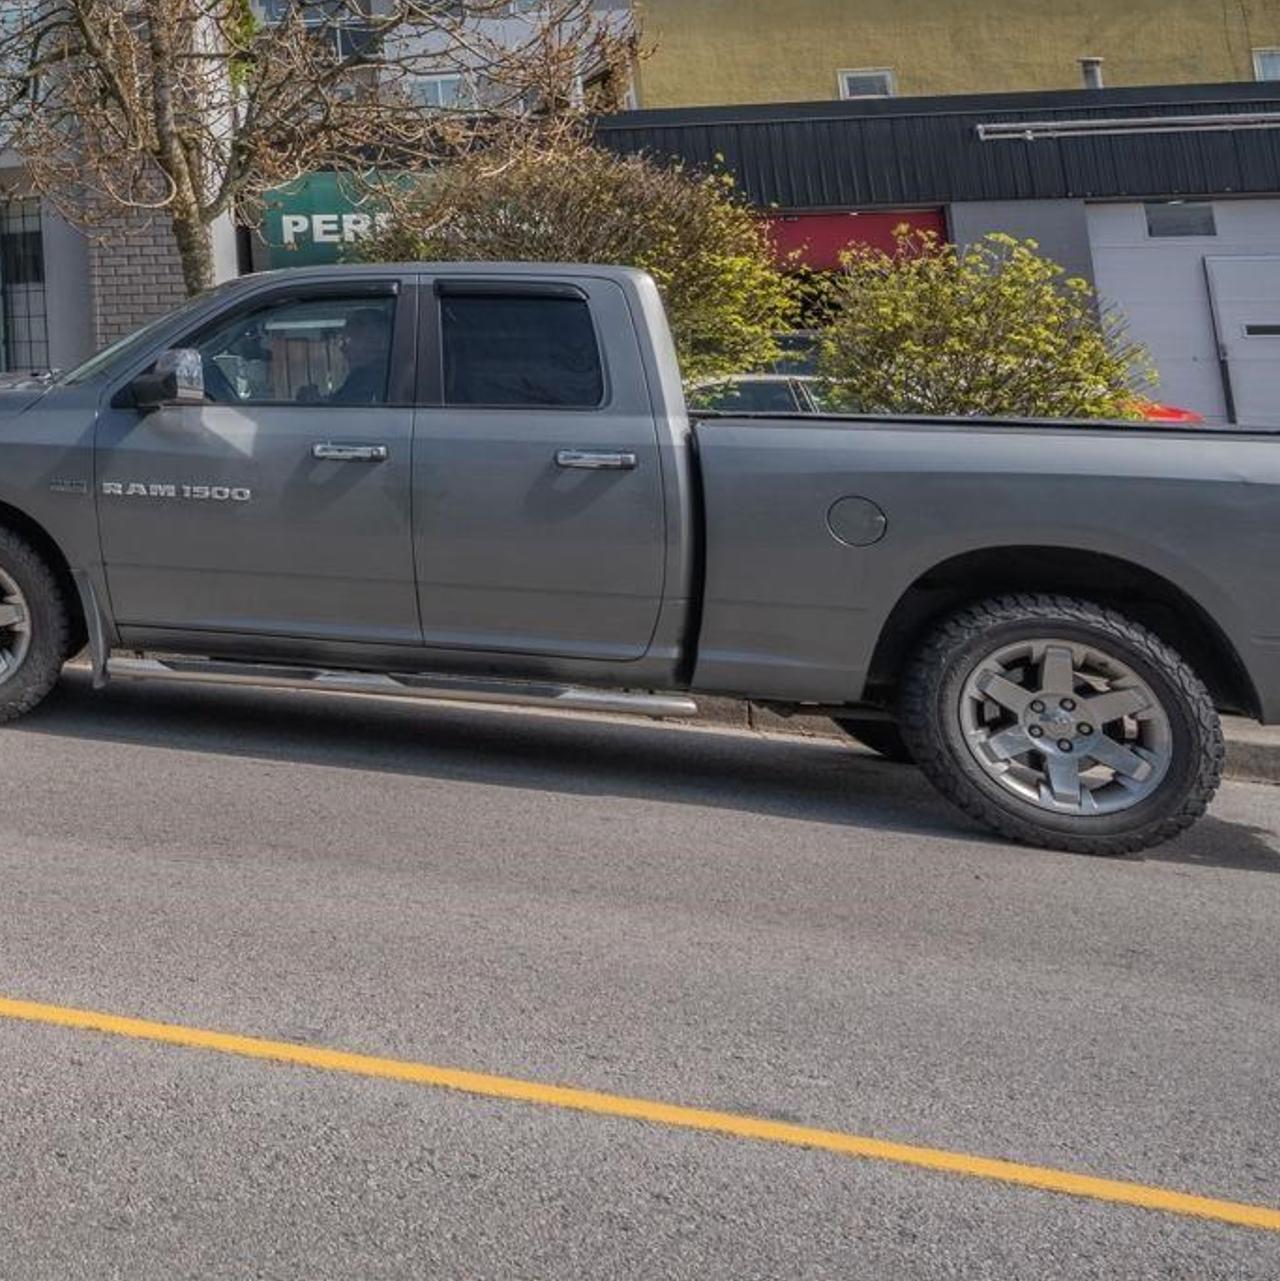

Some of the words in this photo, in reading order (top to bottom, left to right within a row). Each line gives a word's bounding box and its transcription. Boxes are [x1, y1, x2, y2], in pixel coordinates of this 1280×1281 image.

[281, 213, 393, 244] PER
[101, 482, 176, 497] RAM
[182, 484, 251, 501] 1500
